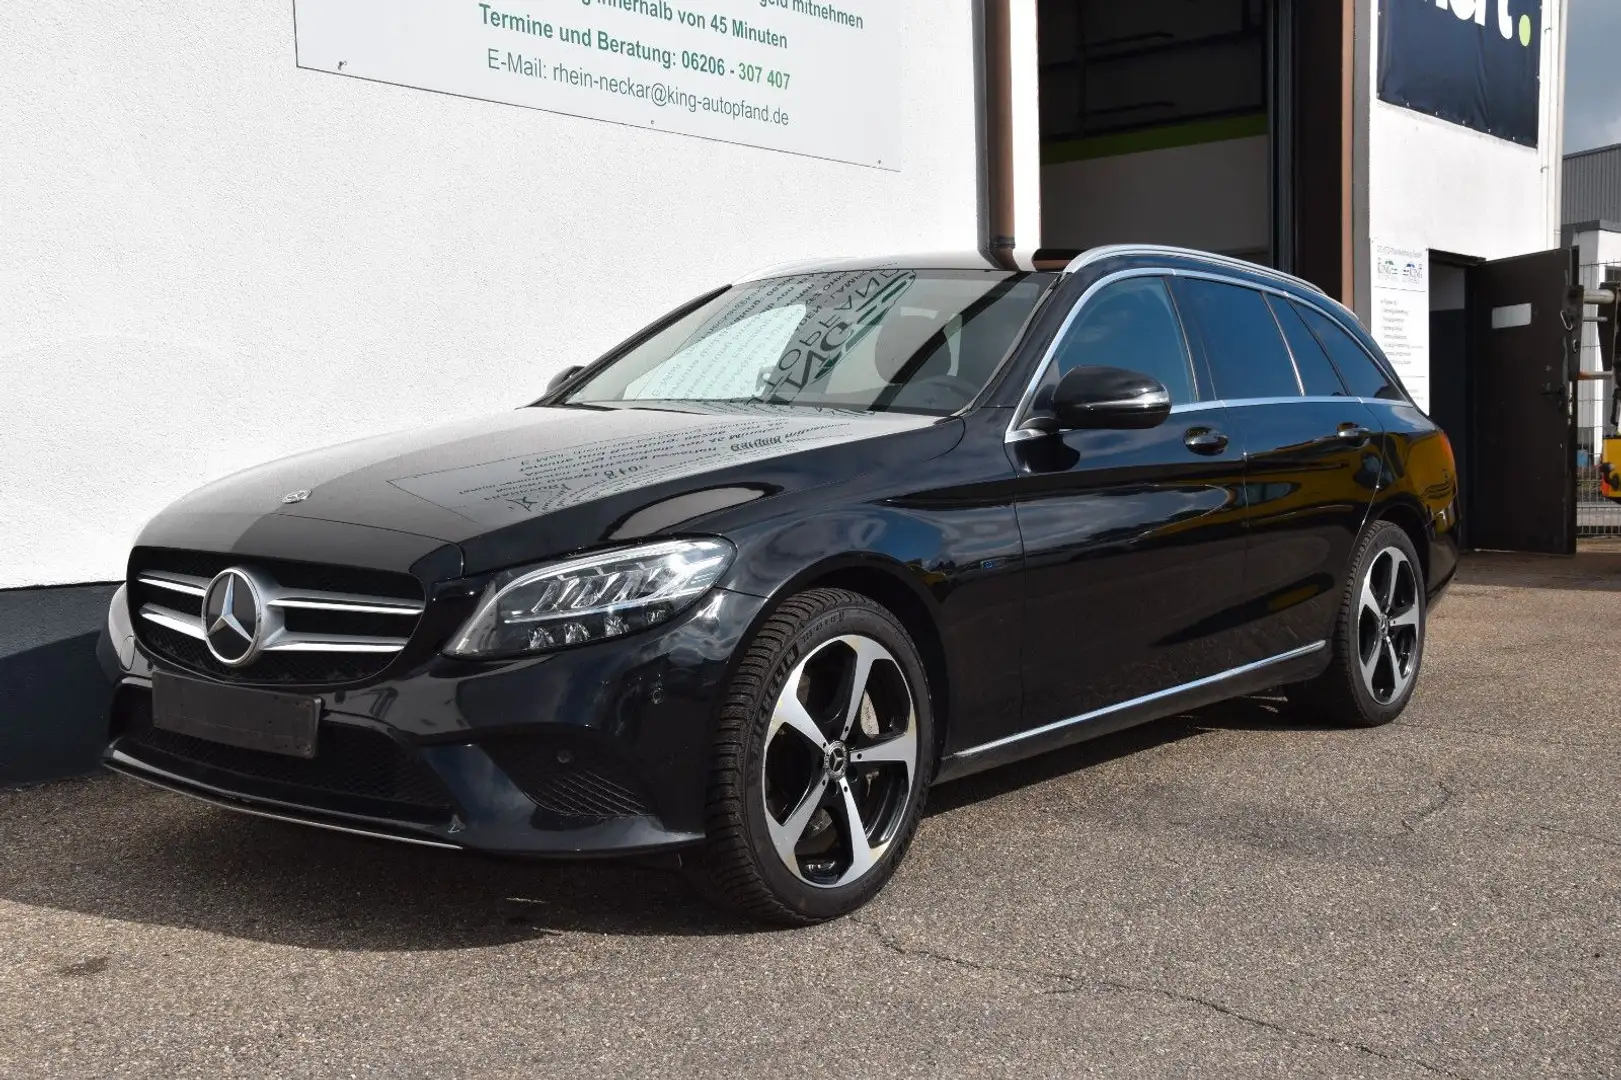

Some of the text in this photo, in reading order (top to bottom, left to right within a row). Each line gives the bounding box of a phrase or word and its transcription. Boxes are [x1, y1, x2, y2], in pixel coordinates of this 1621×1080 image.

[478, 3, 553, 39] Termine
[559, 26, 592, 47] und
[597, 30, 676, 70] Beratung:
[681, 50, 725, 77] 06206
[738, 62, 763, 84] 307
[766, 69, 791, 90] 407
[597, 0, 788, 49] nerhalb von 45 Minuten
[792, 0, 864, 29] mitnehmen
[487, 47, 790, 126] E-Mail: rhein-neckar@king-autopfand.de
